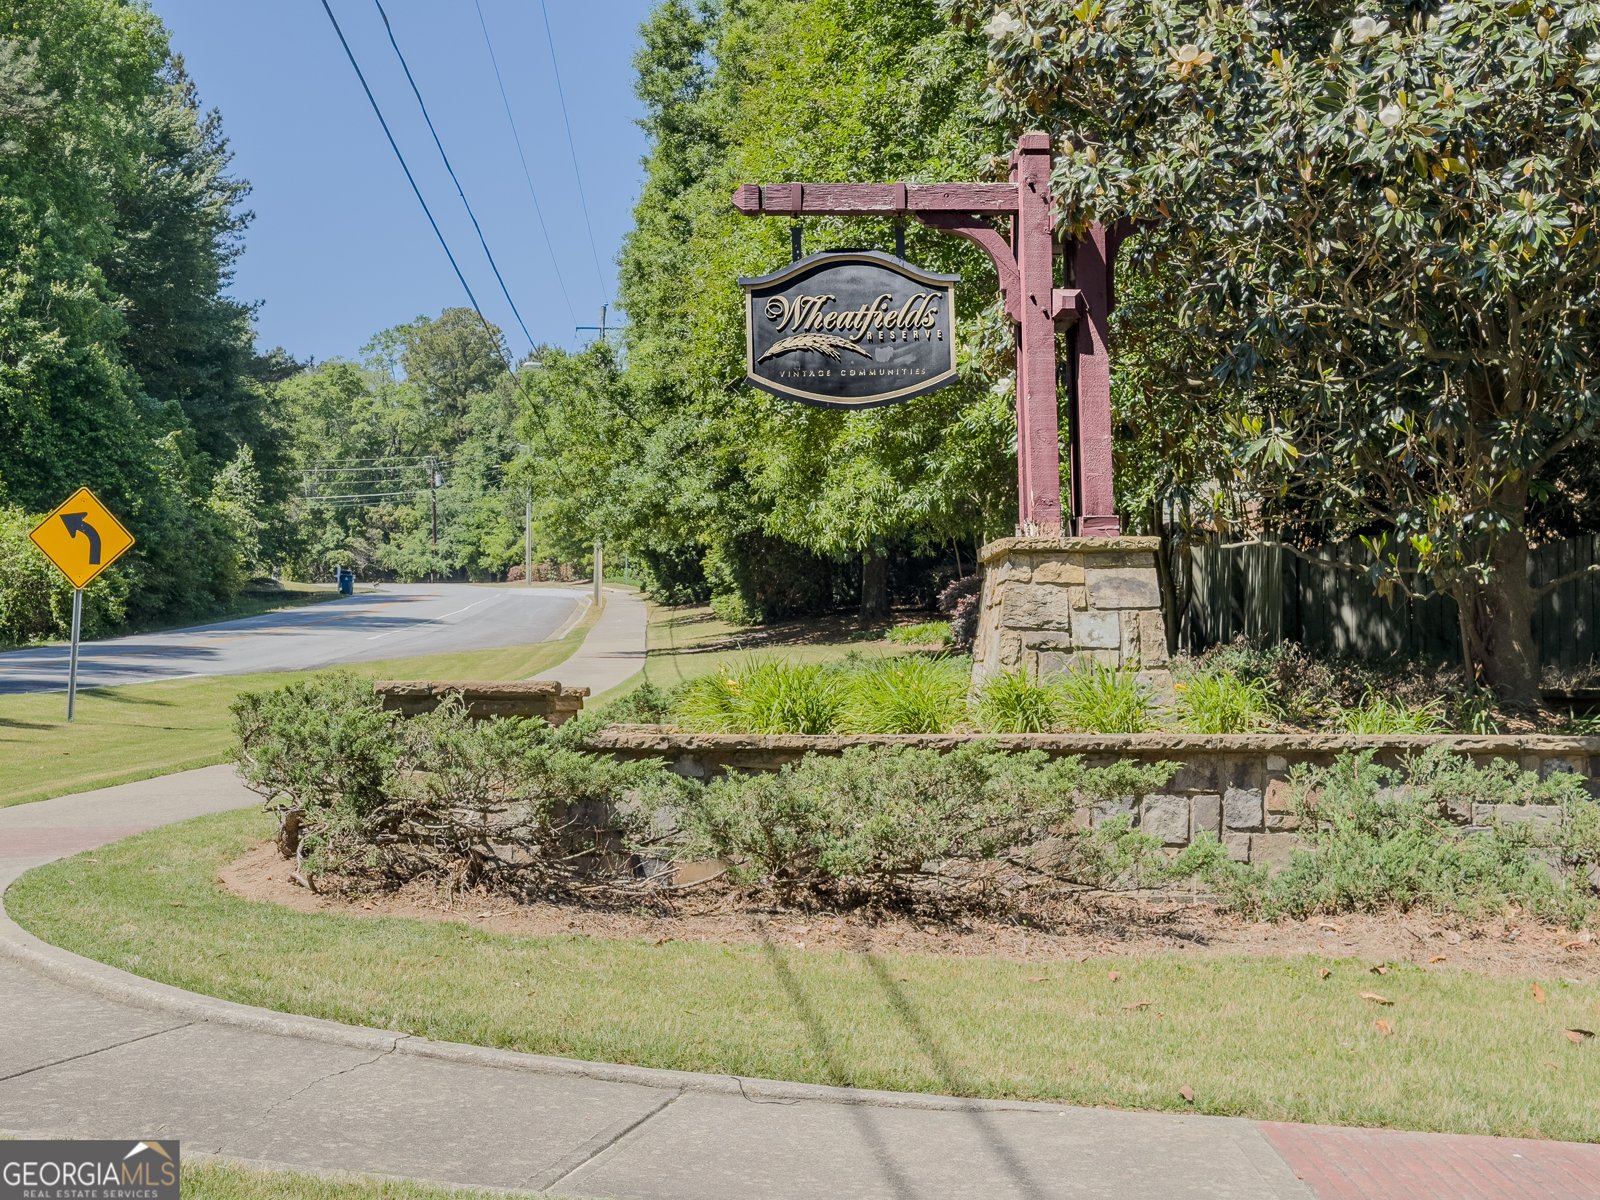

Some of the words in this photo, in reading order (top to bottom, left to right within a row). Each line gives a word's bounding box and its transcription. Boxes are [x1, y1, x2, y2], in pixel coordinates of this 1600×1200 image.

[765, 292, 943, 342] Wheatfields
[867, 330, 943, 340] RESERVE
[779, 370, 832, 378] VINTAGE
[840, 368, 927, 378] COMMUNITIES
